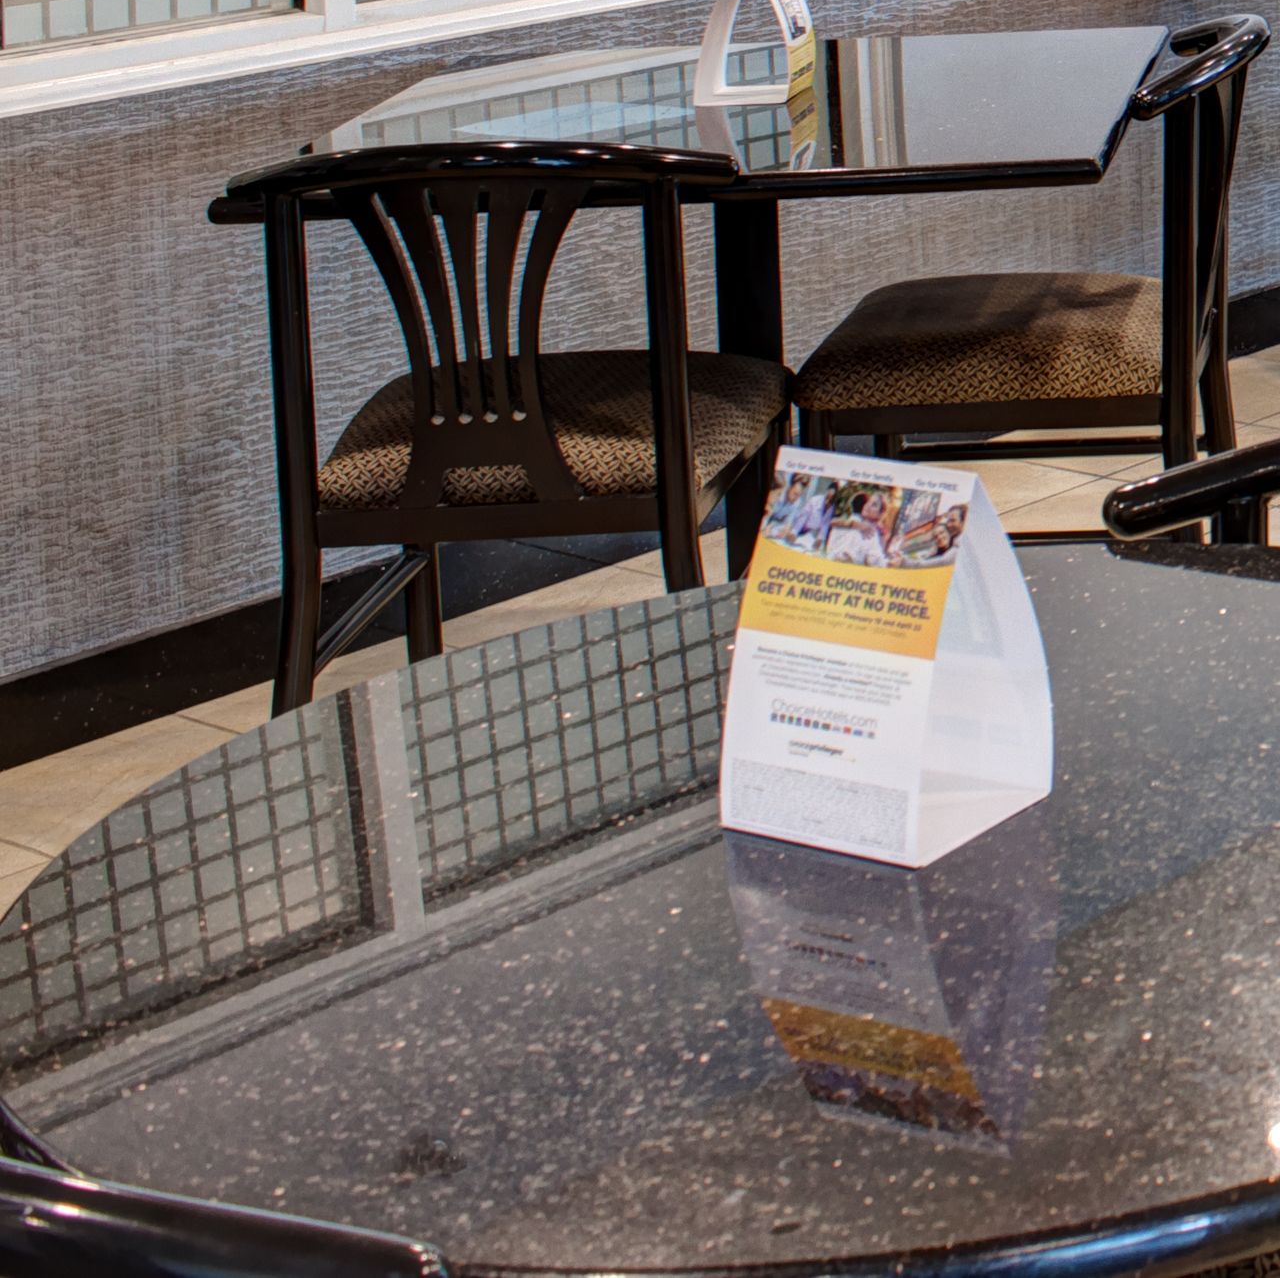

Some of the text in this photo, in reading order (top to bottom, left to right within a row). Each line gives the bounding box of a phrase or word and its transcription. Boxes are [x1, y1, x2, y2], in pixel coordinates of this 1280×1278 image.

[768, 566, 823, 587] CHOOSE
[826, 576, 878, 595] CHOICE
[757, 580, 931, 620] GET A NIGHT AT NO PRICE.
